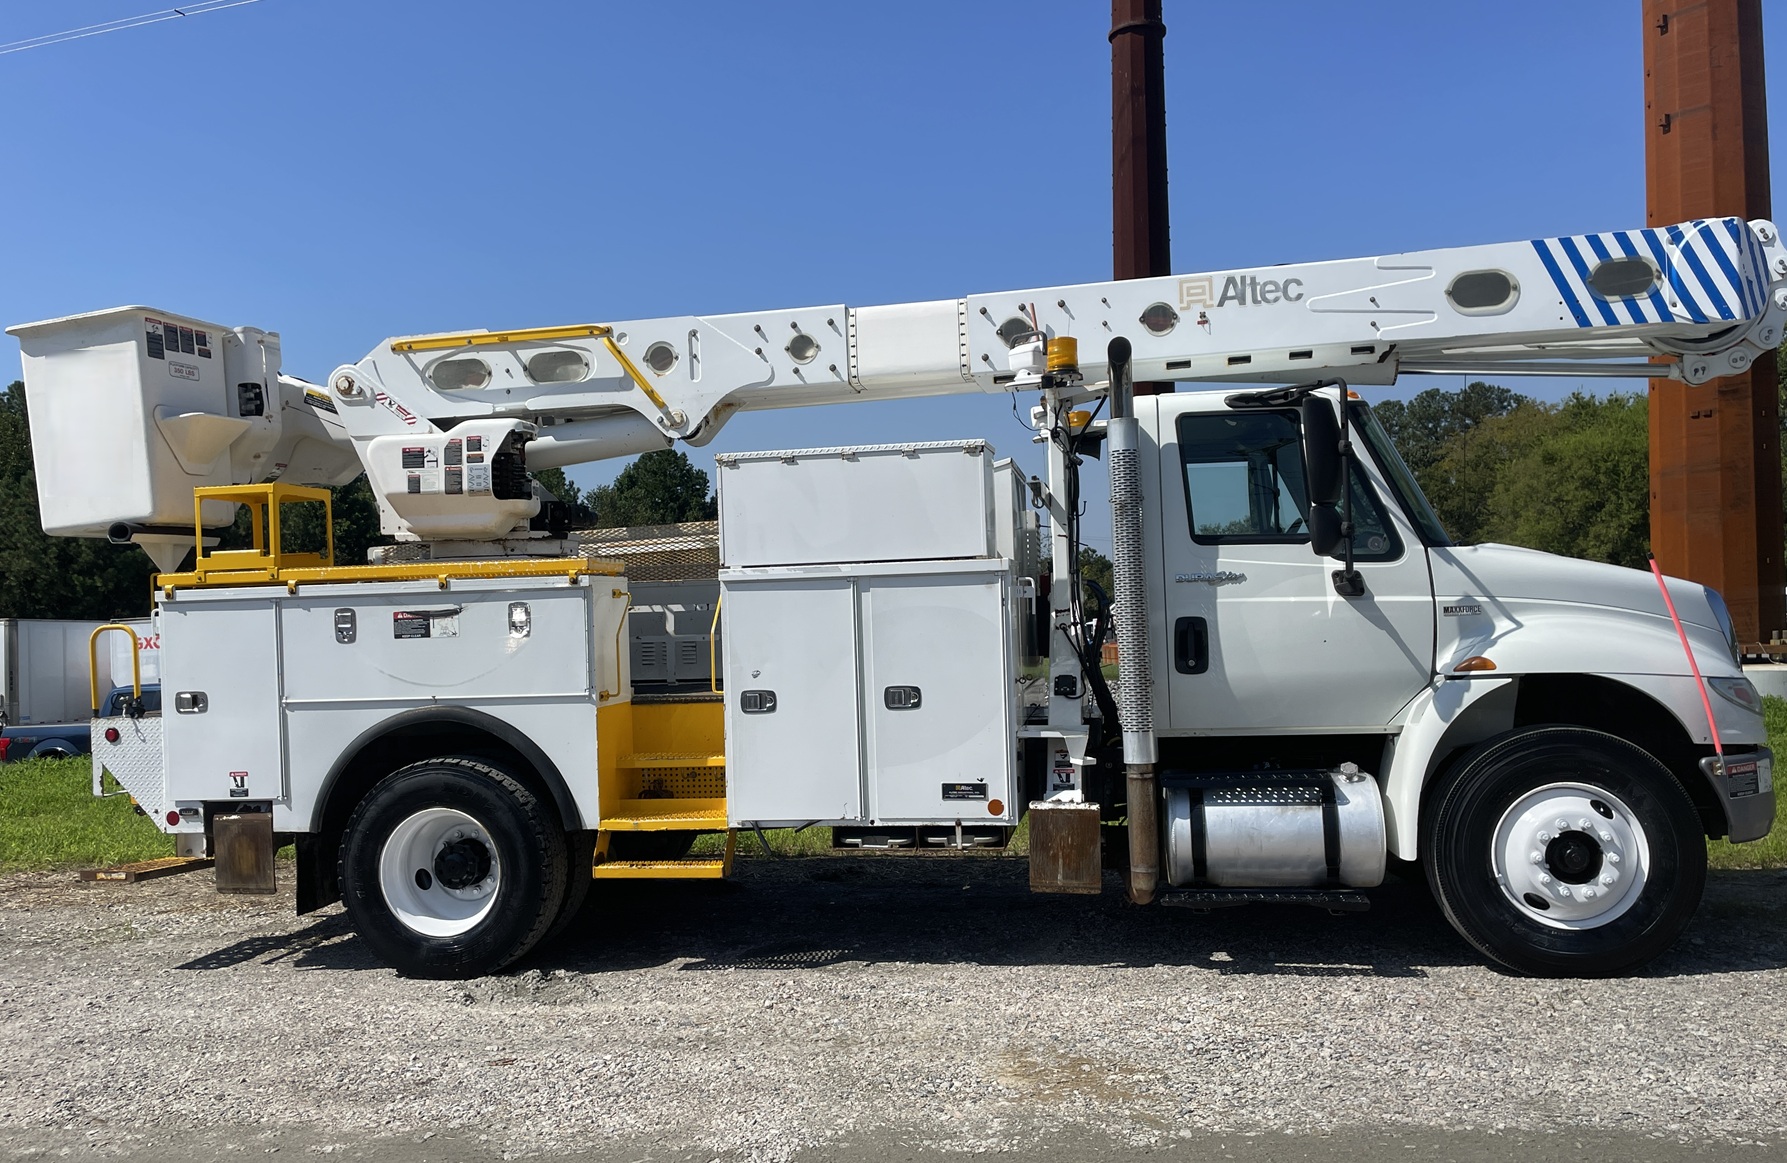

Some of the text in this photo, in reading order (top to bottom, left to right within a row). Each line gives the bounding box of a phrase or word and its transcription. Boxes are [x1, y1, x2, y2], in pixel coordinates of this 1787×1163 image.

[1216, 275, 1304, 308] Altec
[1443, 604, 1482, 614] MAXXFORCE
[1736, 763, 1755, 773] DANGER
